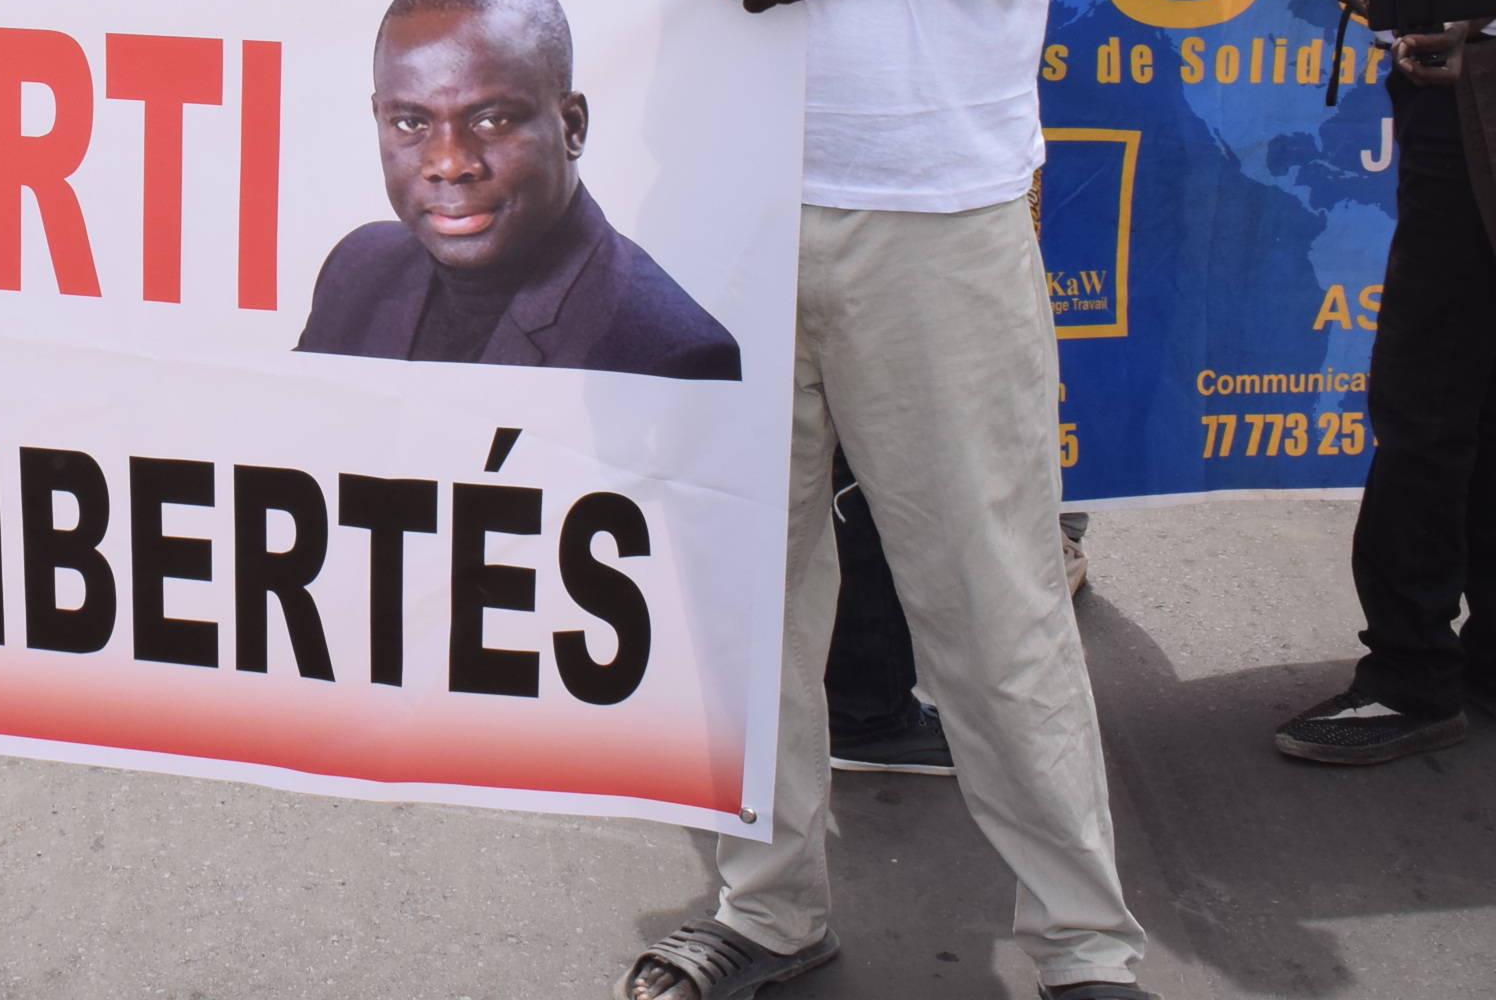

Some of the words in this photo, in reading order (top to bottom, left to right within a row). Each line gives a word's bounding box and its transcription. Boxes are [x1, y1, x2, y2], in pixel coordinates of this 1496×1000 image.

[1096, 37, 1153, 84] de
[1071, 297, 1108, 311] Travail
[1196, 367, 1371, 396] Communica
[1244, 413, 1308, 457] 773
[1317, 412, 1365, 456] 25
